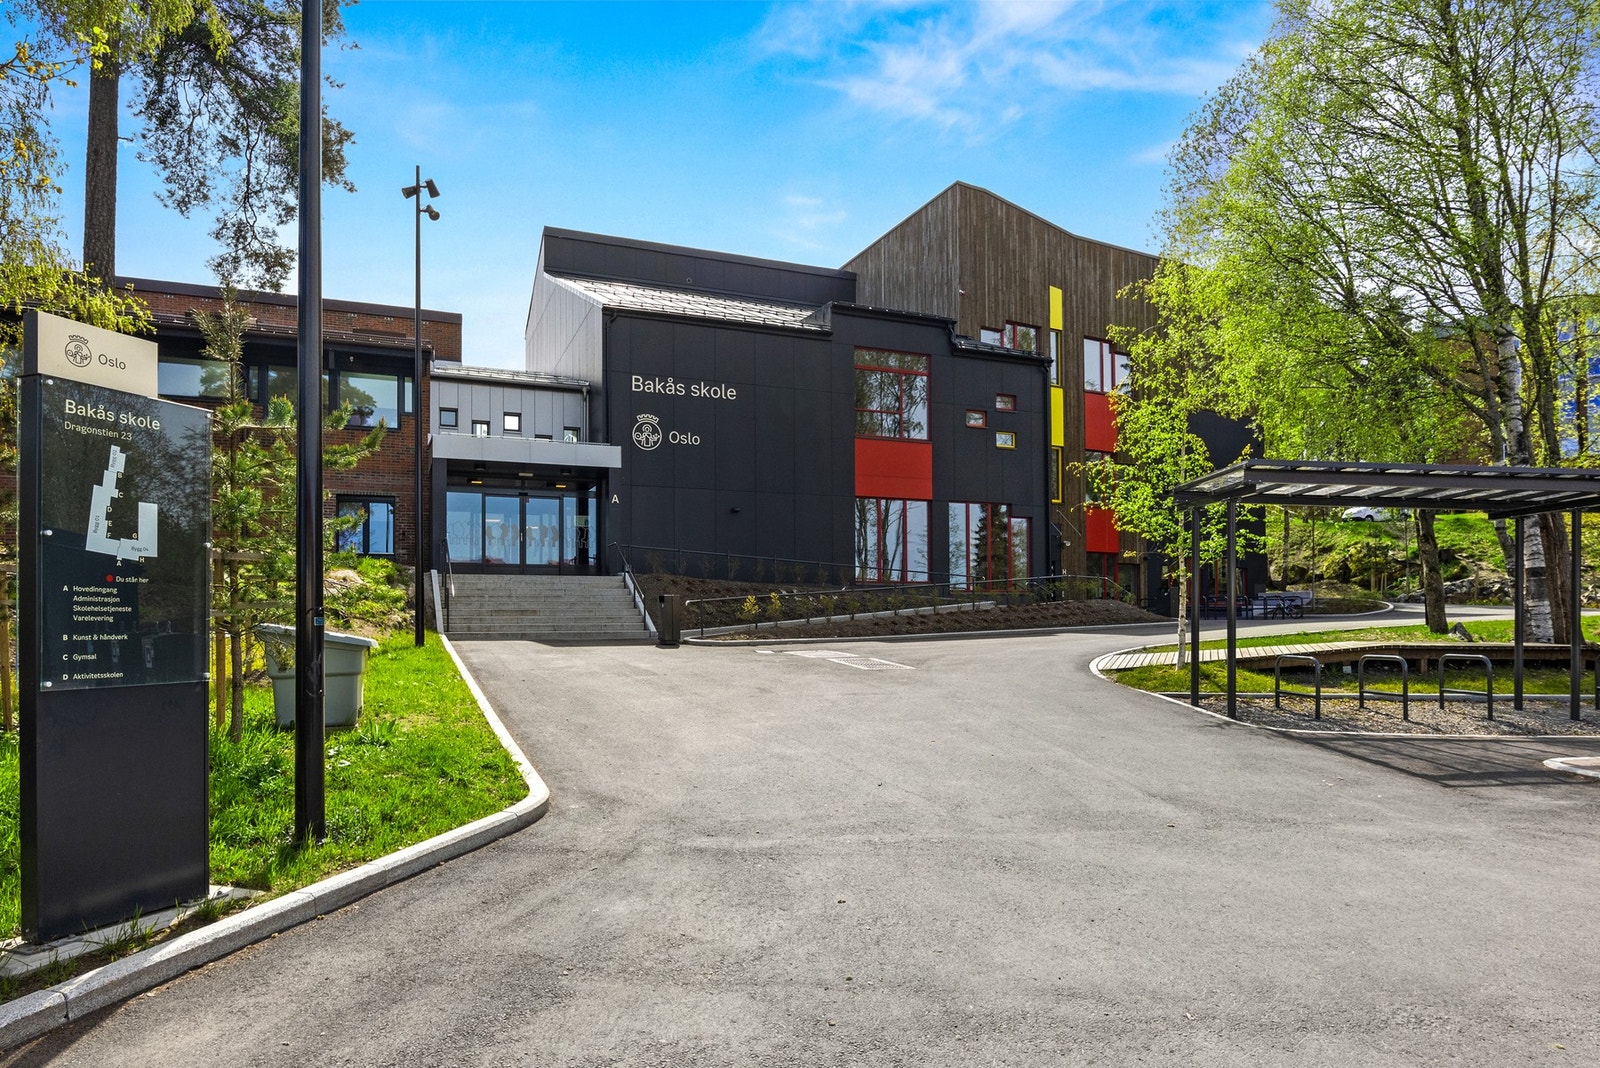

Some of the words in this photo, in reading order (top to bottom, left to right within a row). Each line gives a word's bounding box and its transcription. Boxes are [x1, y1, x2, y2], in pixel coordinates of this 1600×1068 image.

[98, 354, 126, 370] Oslo
[631, 375, 686, 396] Bakås
[690, 381, 737, 400] skole
[65, 399, 115, 422] Bakås
[119, 412, 160, 430] skole
[64, 421, 119, 438] Dragonstien
[121, 431, 133, 441] 23
[668, 430, 701, 446] Oslo
[611, 494, 620, 504] A
[115, 575, 125, 583] Du
[72, 585, 118, 594] Hovedinngang
[72, 595, 121, 604] Administrasjon
[72, 604, 132, 613] Skolehelsetjeneste
[72, 615, 114, 623] Varelevering
[99, 633, 129, 641] håndverk
[72, 653, 97, 662] Gymsal
[72, 671, 124, 680] Aktivitetsskolen
